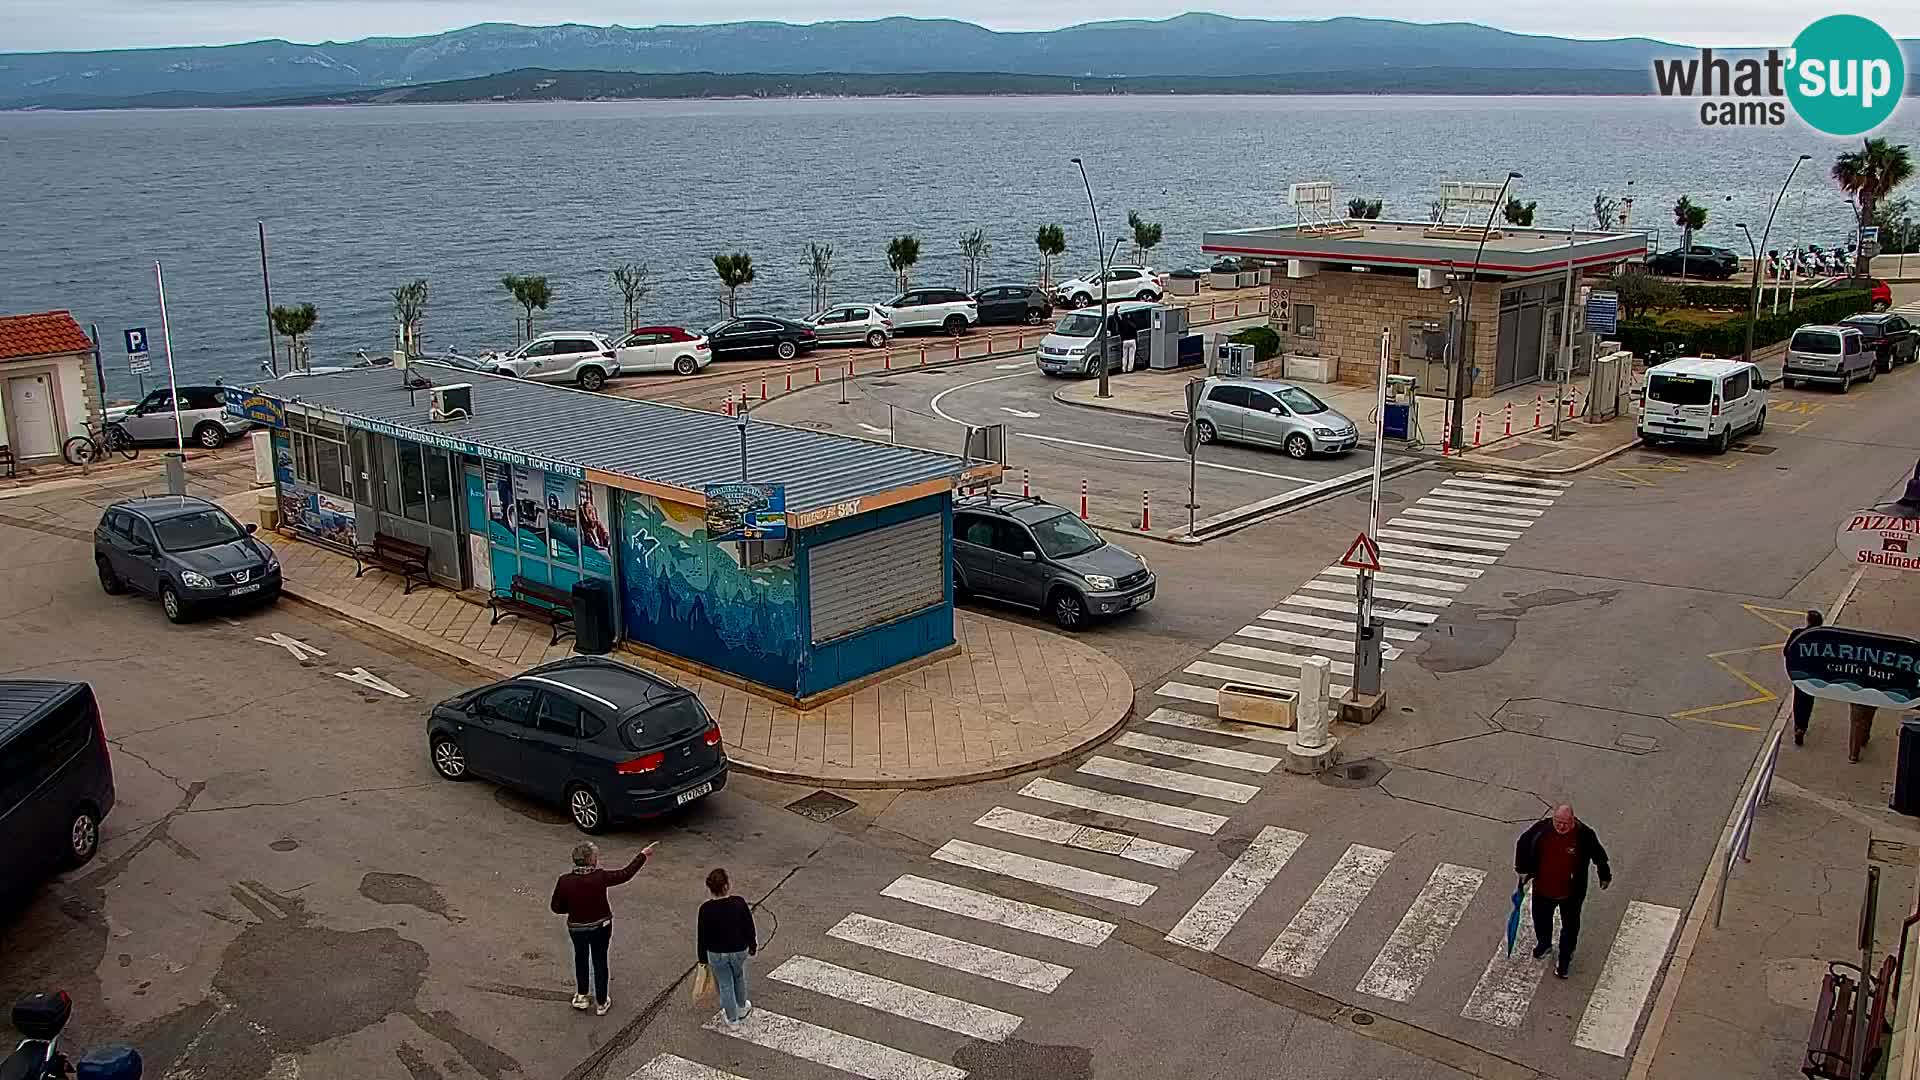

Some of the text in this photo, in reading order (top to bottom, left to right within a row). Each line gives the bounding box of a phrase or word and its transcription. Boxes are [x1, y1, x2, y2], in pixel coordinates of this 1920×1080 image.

[130, 332, 141, 350] P
[395, 428, 435, 445] AUTOBUSNA
[435, 437, 467, 452] POSTAJA
[477, 446, 493, 458] BUS
[493, 450, 526, 465] STATION
[527, 457, 553, 471] TICKET
[555, 462, 581, 478] OFFICE
[1879, 530, 1913, 541] GRILL
[1857, 550, 1920, 569] Skalinad
[1827, 663, 1895, 680] caffe bar
